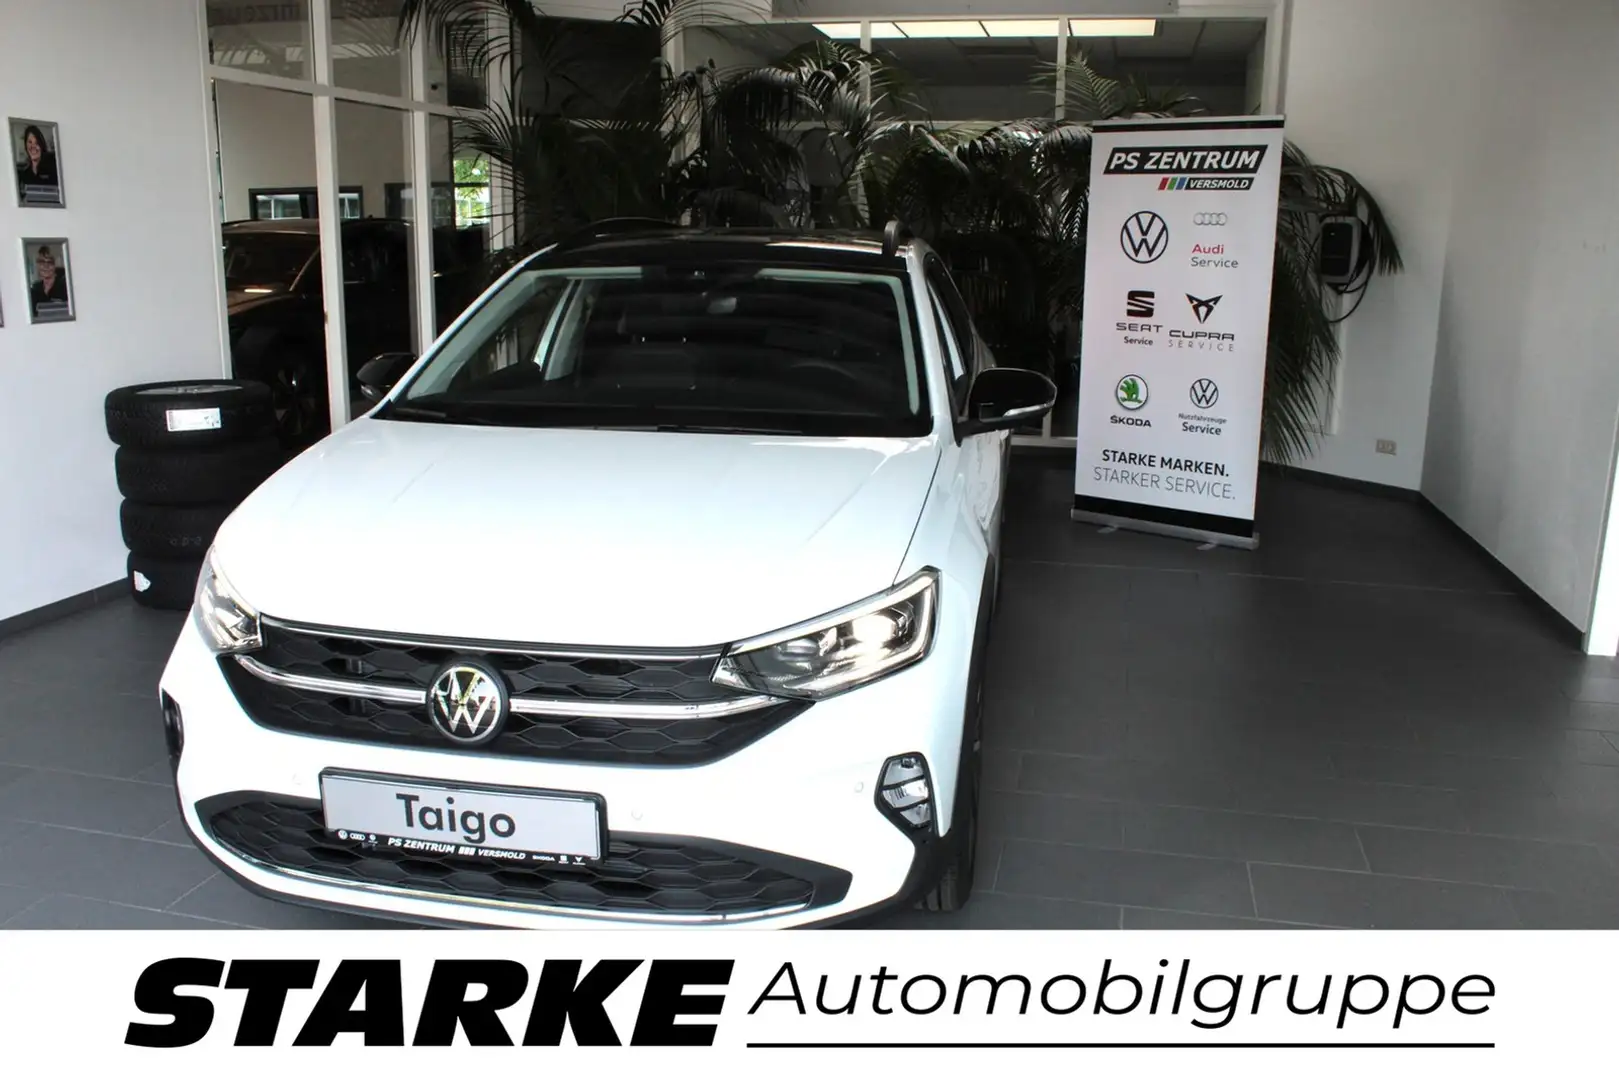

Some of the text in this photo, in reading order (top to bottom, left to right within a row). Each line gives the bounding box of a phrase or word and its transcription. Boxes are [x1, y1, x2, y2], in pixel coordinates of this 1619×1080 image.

[1109, 150, 1260, 170] PS ZENTRUM
[1189, 179, 1250, 189] VERSMOLD
[1191, 244, 1224, 255] Audi
[1190, 257, 1239, 269] Service
[1116, 322, 1163, 333] SEAT
[1123, 336, 1154, 346] Service
[1168, 329, 1235, 341] CUPRA
[1168, 339, 1235, 352] SERVICE
[1182, 421, 1222, 436] Service
[1102, 449, 1230, 477] STARKE MARKEN.
[1094, 466, 1236, 500] STARKER SERVICE.
[396, 793, 516, 844] Taigo
[387, 837, 402, 847] PS
[404, 839, 455, 854] ZENTRUM
[478, 849, 526, 860] VERSMOLD
